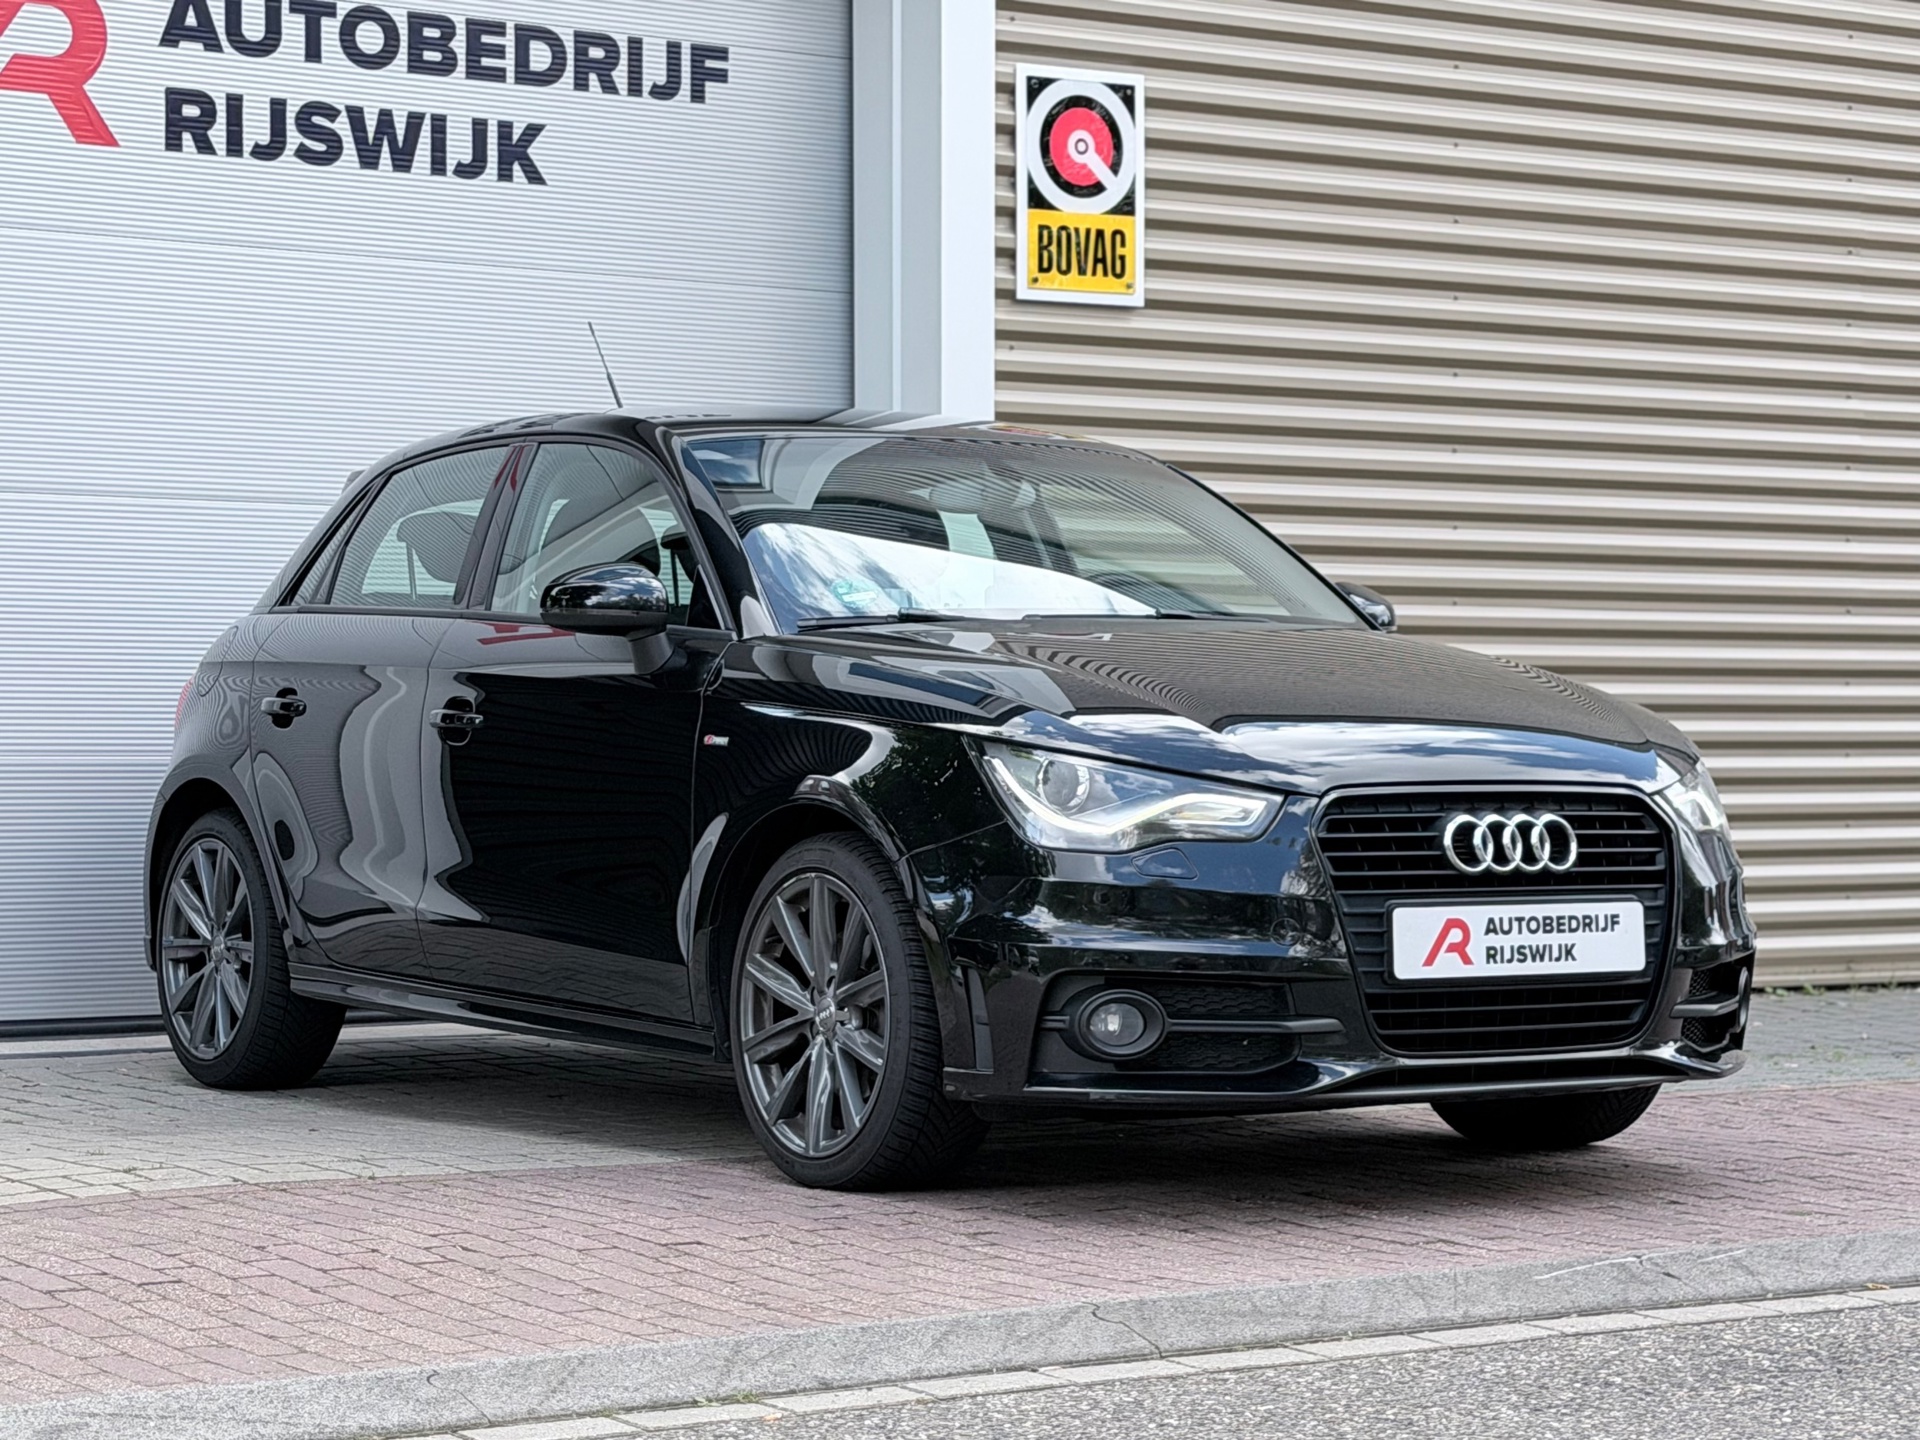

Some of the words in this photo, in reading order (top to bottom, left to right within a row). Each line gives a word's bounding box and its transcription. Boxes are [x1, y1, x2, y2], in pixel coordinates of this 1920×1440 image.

[158, 0, 730, 105] AUTOBEDRIJF
[164, 87, 549, 186] RIJSWIJK
[1037, 223, 1127, 280] BOVAG
[1483, 913, 1621, 936] AUTOBEDRIJF
[1485, 942, 1578, 965] RIJSWIJK
